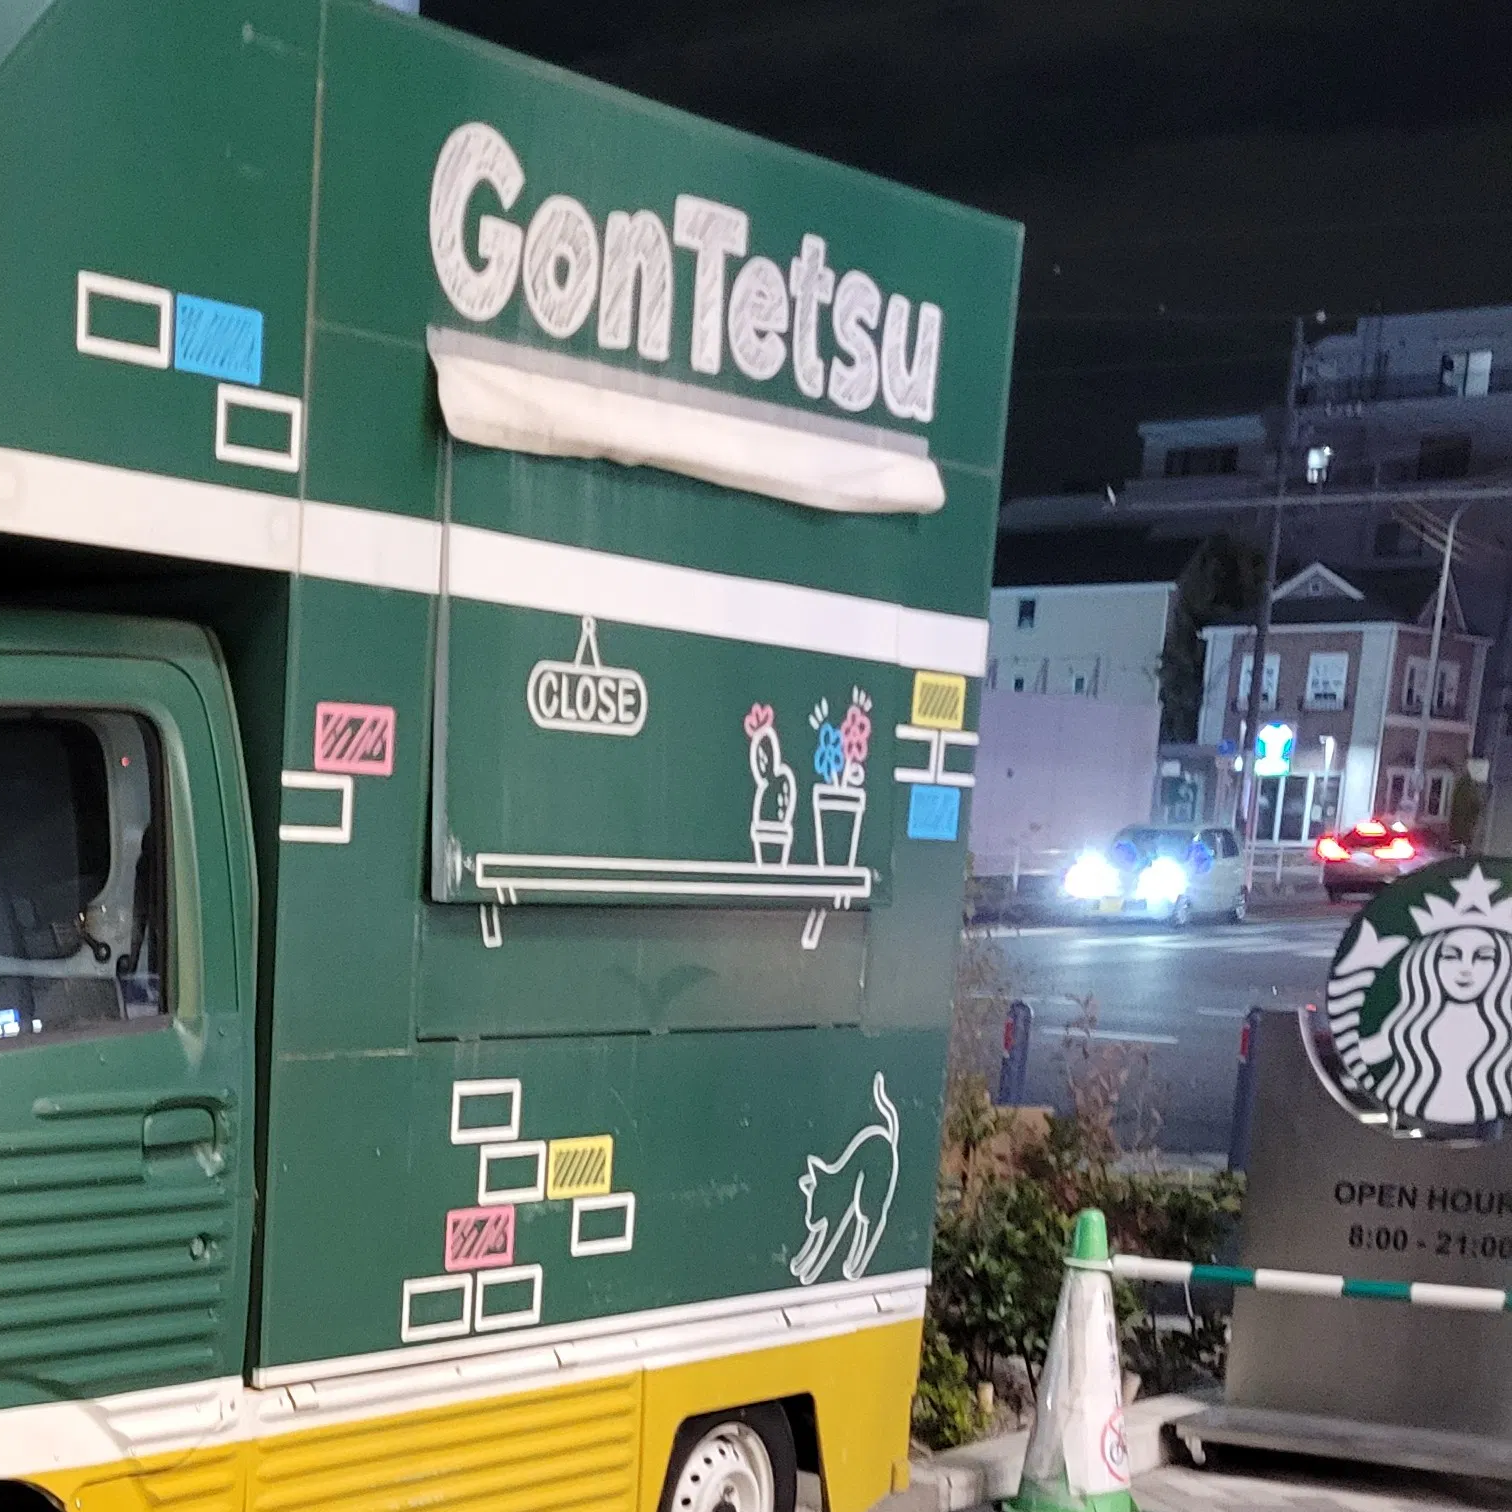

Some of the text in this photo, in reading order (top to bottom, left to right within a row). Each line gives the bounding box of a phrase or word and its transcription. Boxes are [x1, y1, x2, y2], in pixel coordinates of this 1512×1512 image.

[429, 121, 942, 423] GonTetsu
[538, 670, 637, 724] CLOSE
[1334, 1180, 1418, 1211] OPEN
[1348, 1223, 1409, 1251] 8:00
